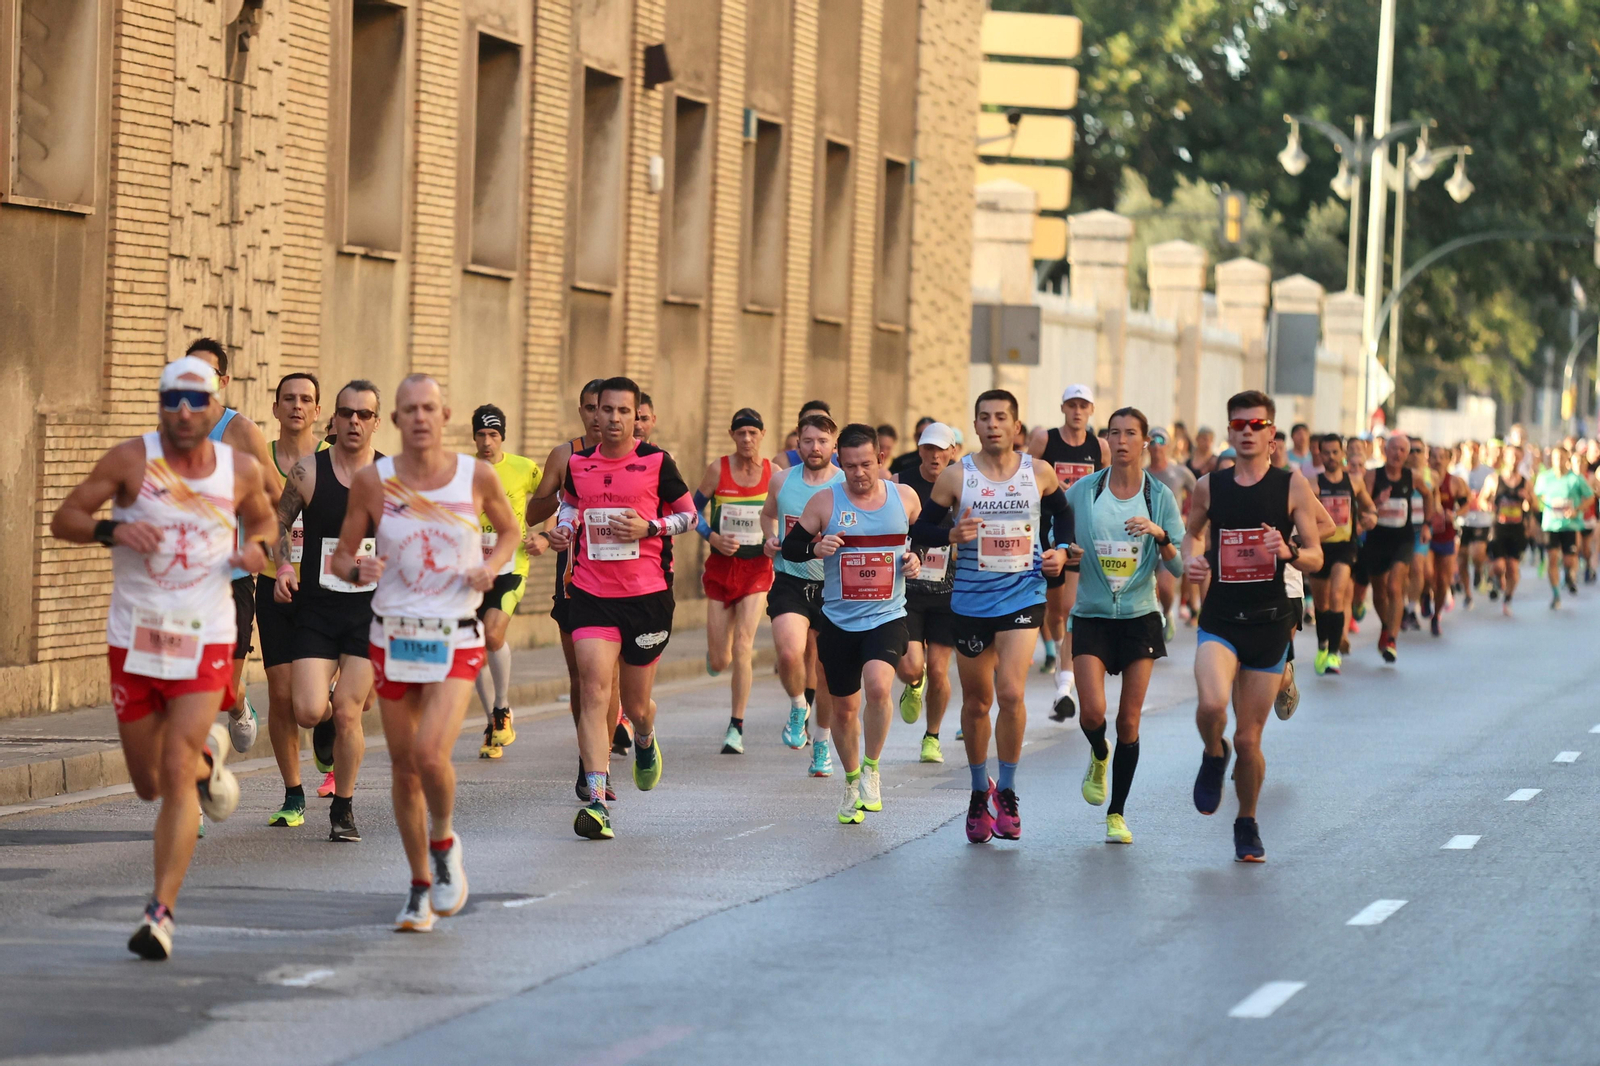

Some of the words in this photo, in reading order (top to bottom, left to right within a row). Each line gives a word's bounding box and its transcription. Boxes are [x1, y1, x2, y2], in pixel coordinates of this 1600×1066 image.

[972, 500, 1030, 510] MARACENA
[732, 519, 754, 527] 14761
[993, 539, 1020, 548] 10371
[1237, 548, 1255, 557] 285
[1101, 559, 1127, 569] 10704
[859, 569, 876, 578] 609
